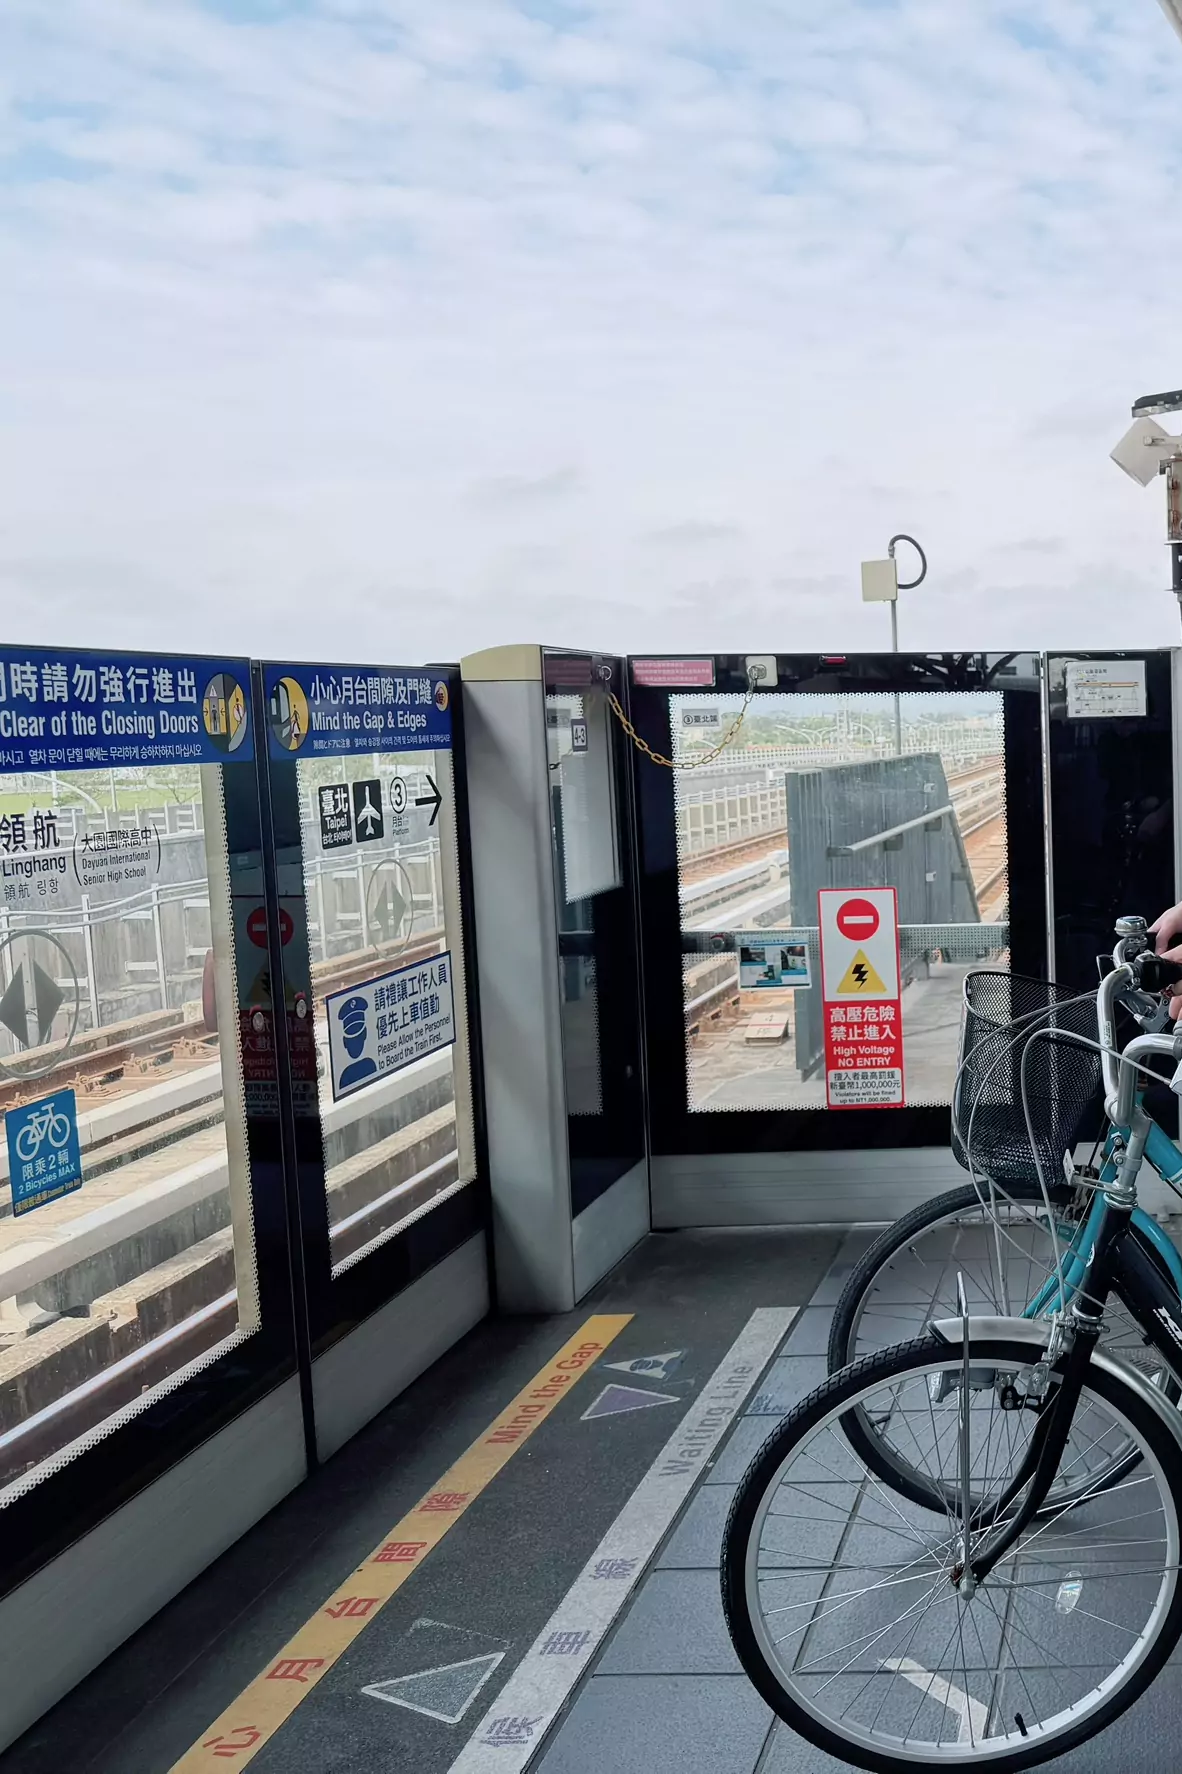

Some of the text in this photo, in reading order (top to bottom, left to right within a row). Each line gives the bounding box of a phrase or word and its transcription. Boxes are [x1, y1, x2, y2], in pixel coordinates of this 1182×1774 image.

[0, 661, 197, 704] 時請勿強行進出
[311, 674, 432, 705] 小心月台間隙及門縫
[1, 710, 199, 739] Clear of the Closing Doors
[312, 710, 427, 732] Mind the Gap & Edges
[28, 749, 47, 764] 열차
[48, 748, 66, 763] 문이
[110, 745, 140, 760] 무리하게
[175, 743, 203, 757] 마십시오
[320, 787, 349, 816] 臺北
[0, 810, 60, 853] 領航
[325, 814, 348, 830] Taipei
[81, 826, 152, 853] 大園國際高中
[2, 856, 67, 878] Linghang
[82, 850, 151, 870] Dayuan International
[83, 866, 147, 886] Senior High School
[373, 963, 448, 1012] 請禮讓工作人員
[376, 992, 440, 1040] 優先上車值勤
[830, 1005, 895, 1023] 高壓危險
[378, 1013, 451, 1056] Please Allow the Personnel
[831, 1024, 896, 1041] 禁止進入
[378, 1059, 385, 1070] to
[386, 1051, 404, 1067] Board
[404, 1046, 414, 1056] the
[415, 1039, 429, 1051] Train
[833, 1046, 895, 1056] High Voltage
[838, 1056, 891, 1067] NO ENTRY
[18, 1185, 25, 1195] 2
[25, 1172, 57, 1192] Bicycles
[58, 1163, 75, 1177] MAX
[485, 1341, 604, 1445] Mind the Gap
[658, 1365, 753, 1478] Waiting Line
